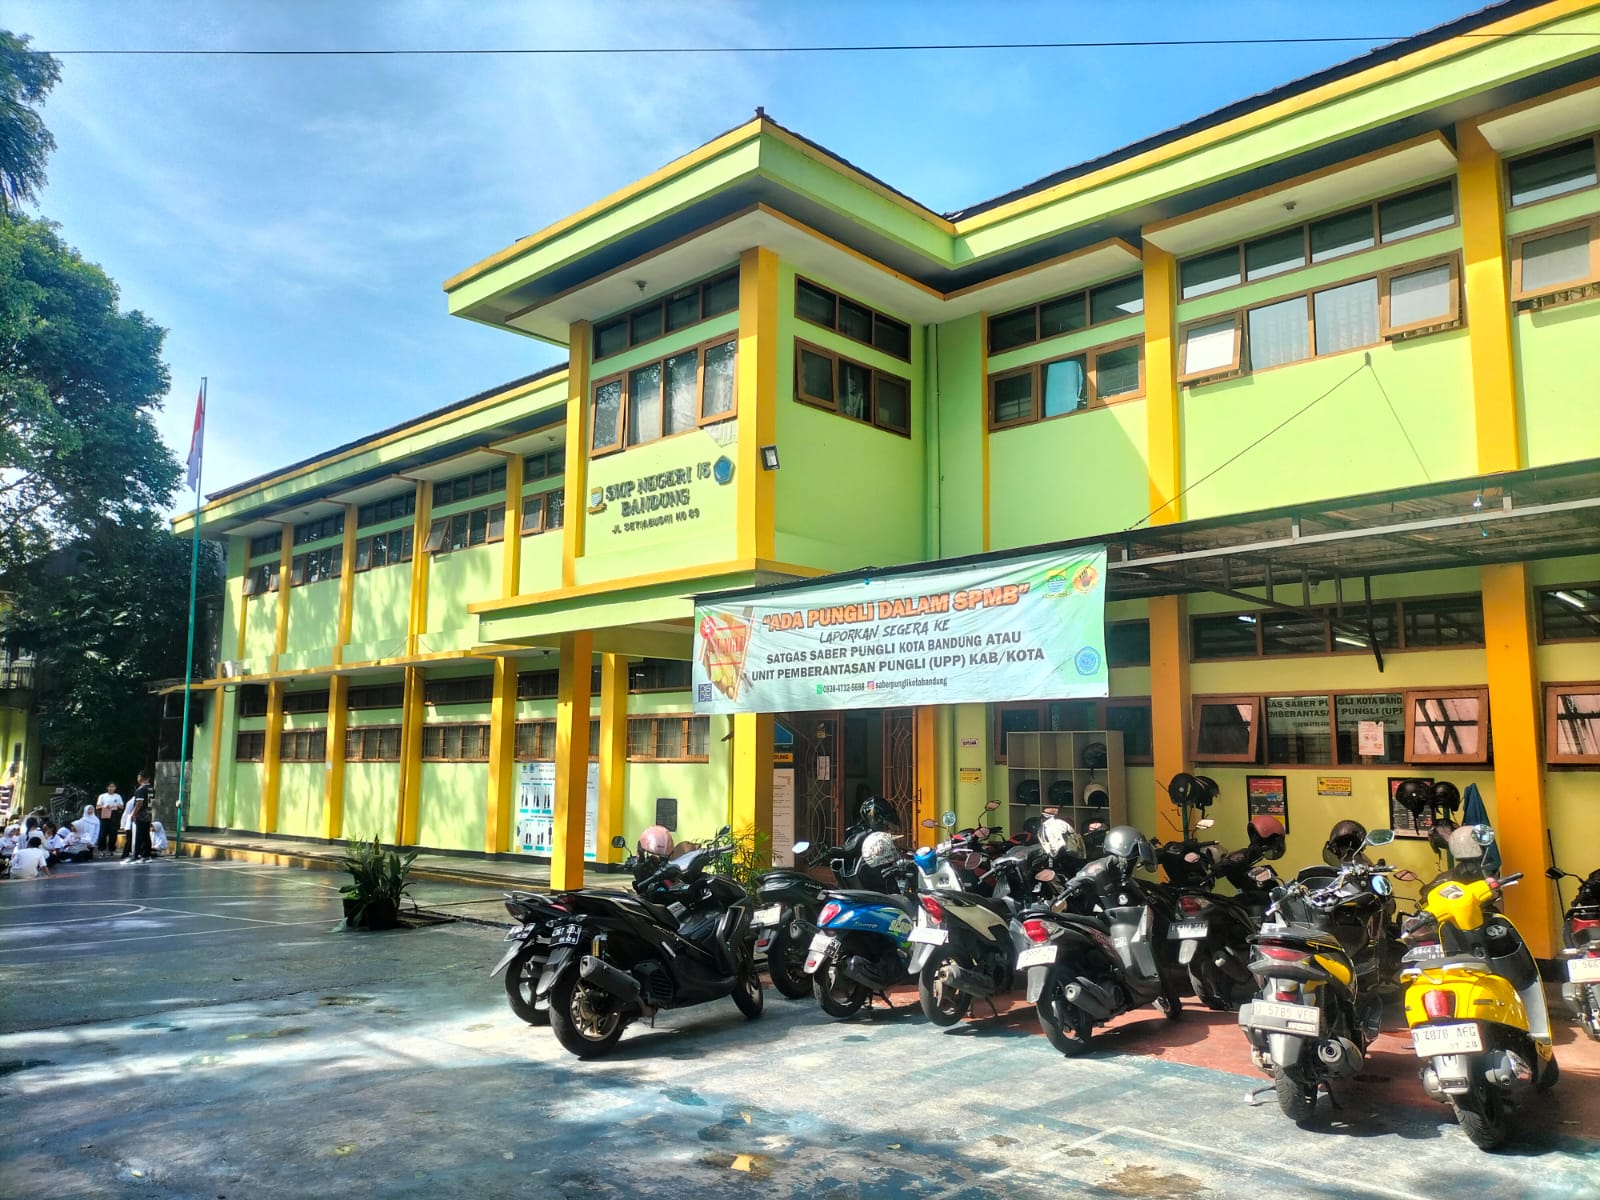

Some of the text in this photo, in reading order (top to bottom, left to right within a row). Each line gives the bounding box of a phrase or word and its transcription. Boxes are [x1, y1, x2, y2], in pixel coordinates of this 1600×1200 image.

[605, 480, 636, 502] SMP
[637, 466, 692, 495] NEGERI
[621, 488, 691, 518] BANDUNG
[806, 600, 877, 628] PUNGLI
[878, 592, 950, 620] DALAM
[766, 630, 1022, 665] SATGAS SABER PUNGLI KOTA BANDUNG ATAU
[819, 619, 950, 645] LAPORKAN SEGERA KE
[751, 647, 1045, 682] UNIT PEMBERANTASAN PUNGLI (UPP) KAB/KOTA
